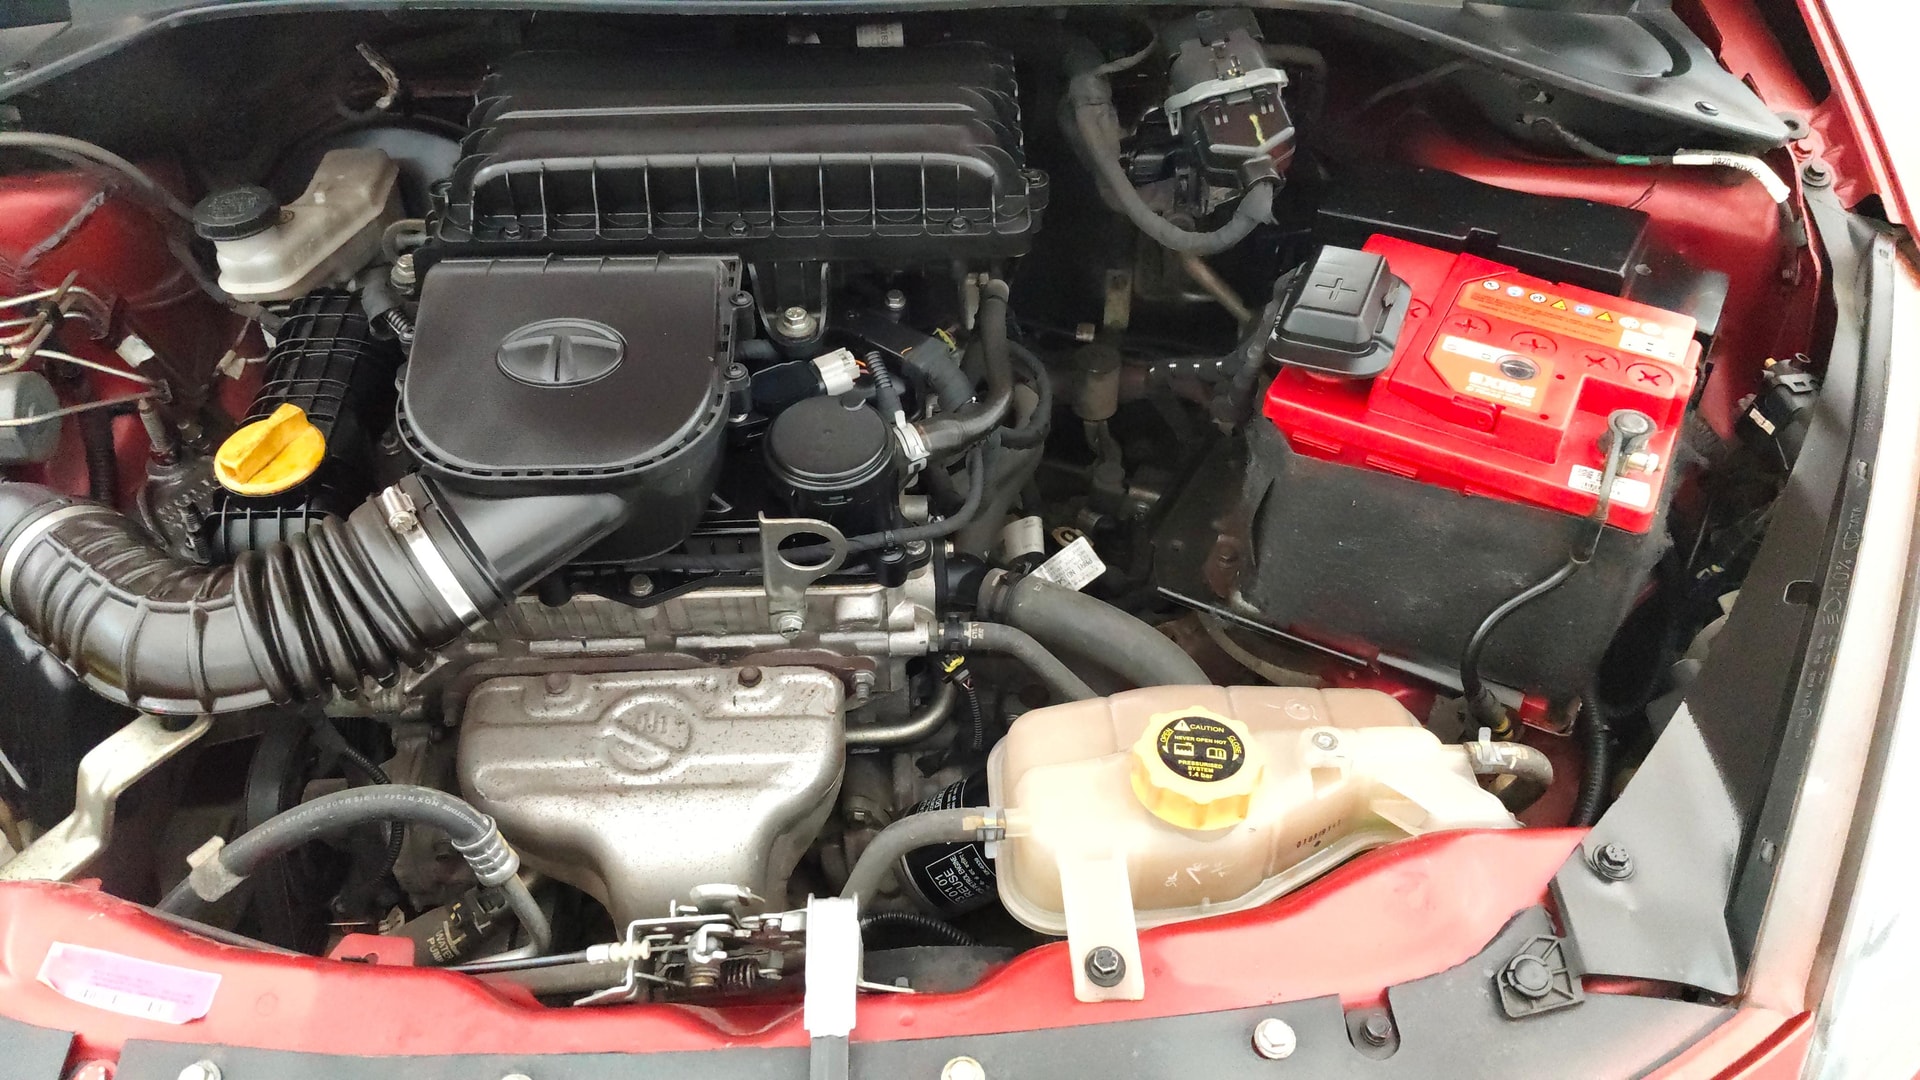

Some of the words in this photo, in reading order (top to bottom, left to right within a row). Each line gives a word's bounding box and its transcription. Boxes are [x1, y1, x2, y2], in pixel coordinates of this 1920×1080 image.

[1190, 723, 1225, 733] CAUTION
[1160, 727, 1174, 743] OPEN
[1174, 734, 1195, 742] NEVER
[1229, 735, 1242, 754] CLOSE
[1177, 759, 1224, 769] PRESSURISED
[1187, 765, 1214, 773] SYSTEM
[1187, 770, 1199, 778] 1.4
[950, 856, 965, 874] ENGINE
[935, 874, 947, 886] 01
[943, 868, 972, 898] REUSE
[963, 872, 977, 889] PETROL
